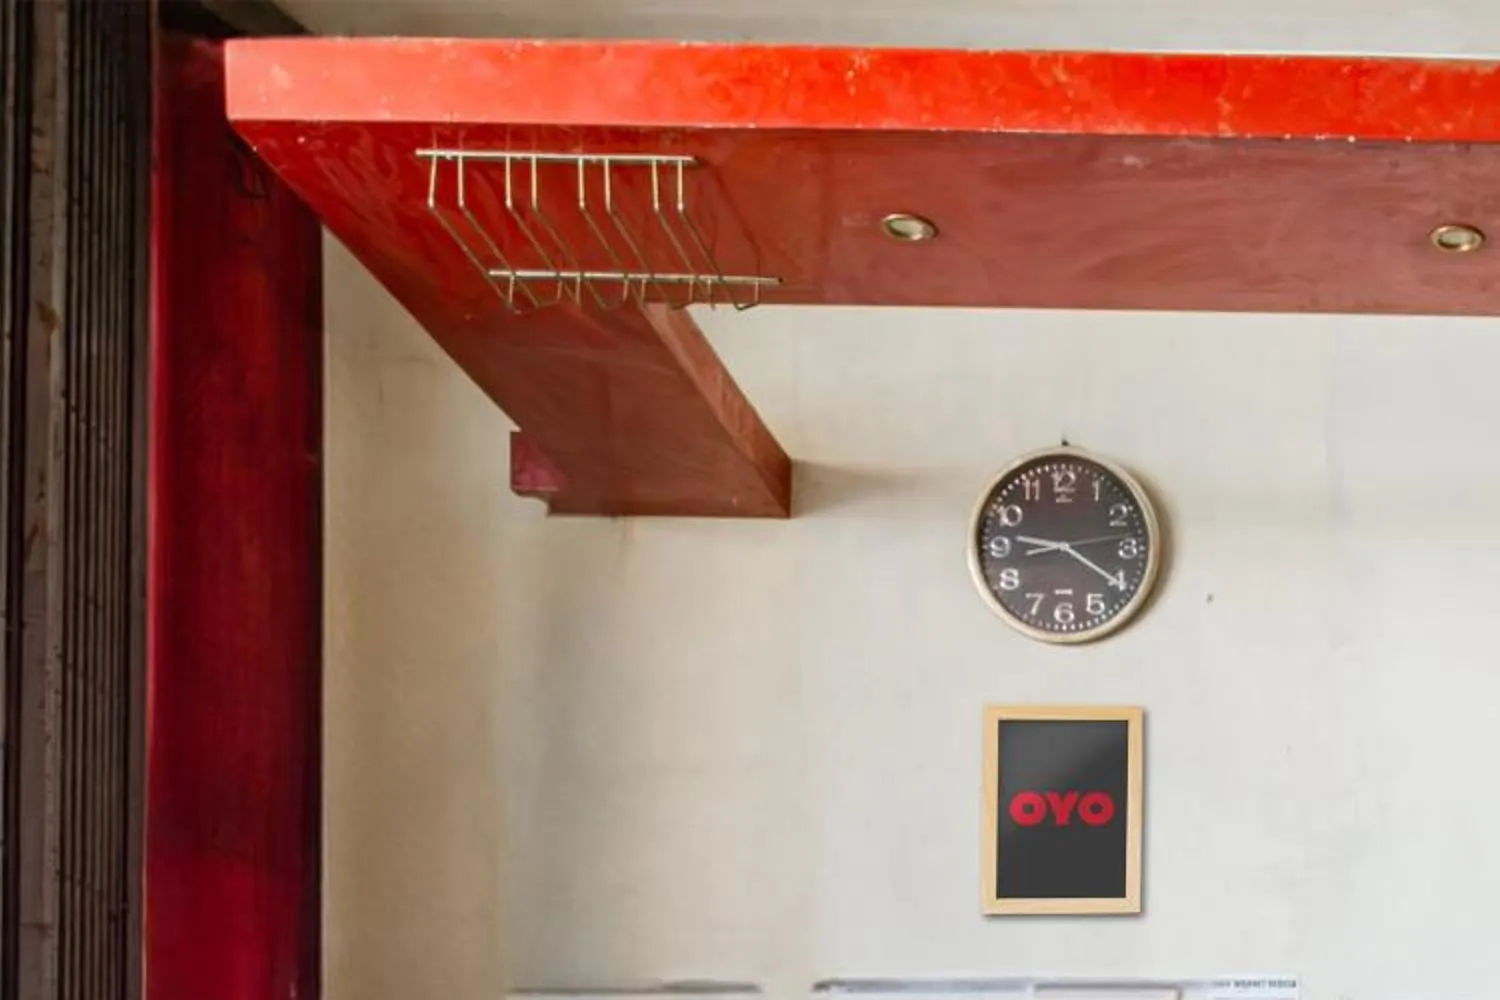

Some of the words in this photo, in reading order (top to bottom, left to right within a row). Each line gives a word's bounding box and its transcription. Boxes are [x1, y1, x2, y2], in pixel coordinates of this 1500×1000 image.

[1023, 479, 1041, 502] 11
[1052, 470, 1076, 493] 12
[997, 504, 1023, 527] 10
[1108, 503, 1128, 526] 2
[990, 535, 1011, 558] 9
[1118, 537, 1138, 559] 3
[999, 568, 1020, 590] 8
[1107, 570, 1127, 591] 4
[1025, 593, 1044, 616] 7
[1054, 602, 1075, 624] 6
[1085, 593, 1105, 615] 5
[1009, 790, 1115, 827] OYO
